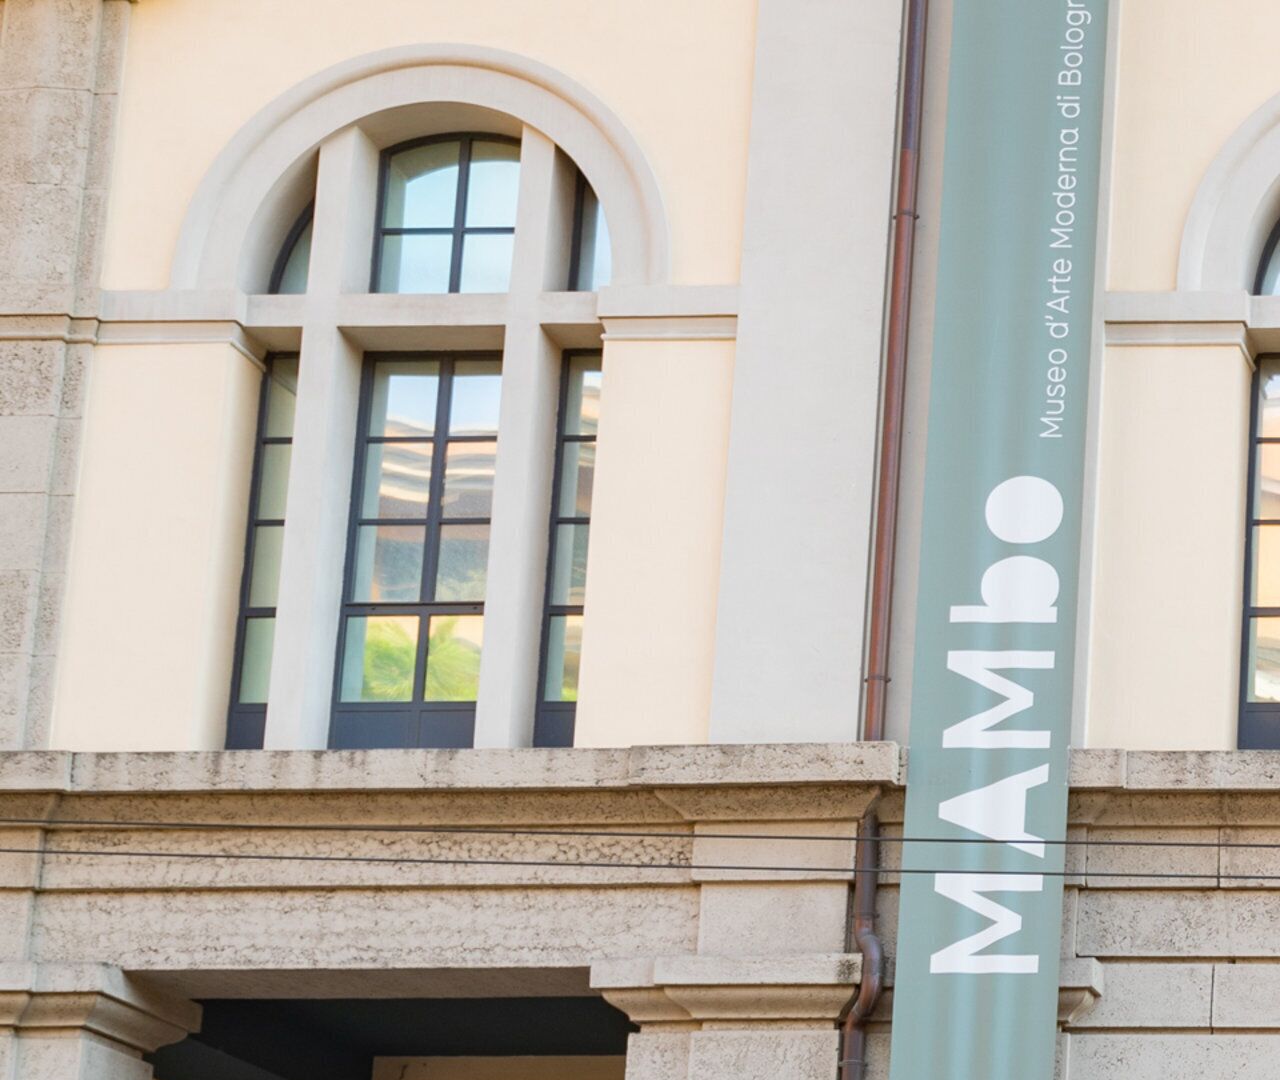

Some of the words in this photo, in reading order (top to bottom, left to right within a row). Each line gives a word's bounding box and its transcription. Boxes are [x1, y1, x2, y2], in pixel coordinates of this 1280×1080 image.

[1056, 94, 1081, 119] di
[1048, 127, 1080, 249] Moderna
[1044, 257, 1073, 339] d'Arte
[1039, 348, 1068, 438] Museo
[930, 475, 1064, 974] MAMbo
